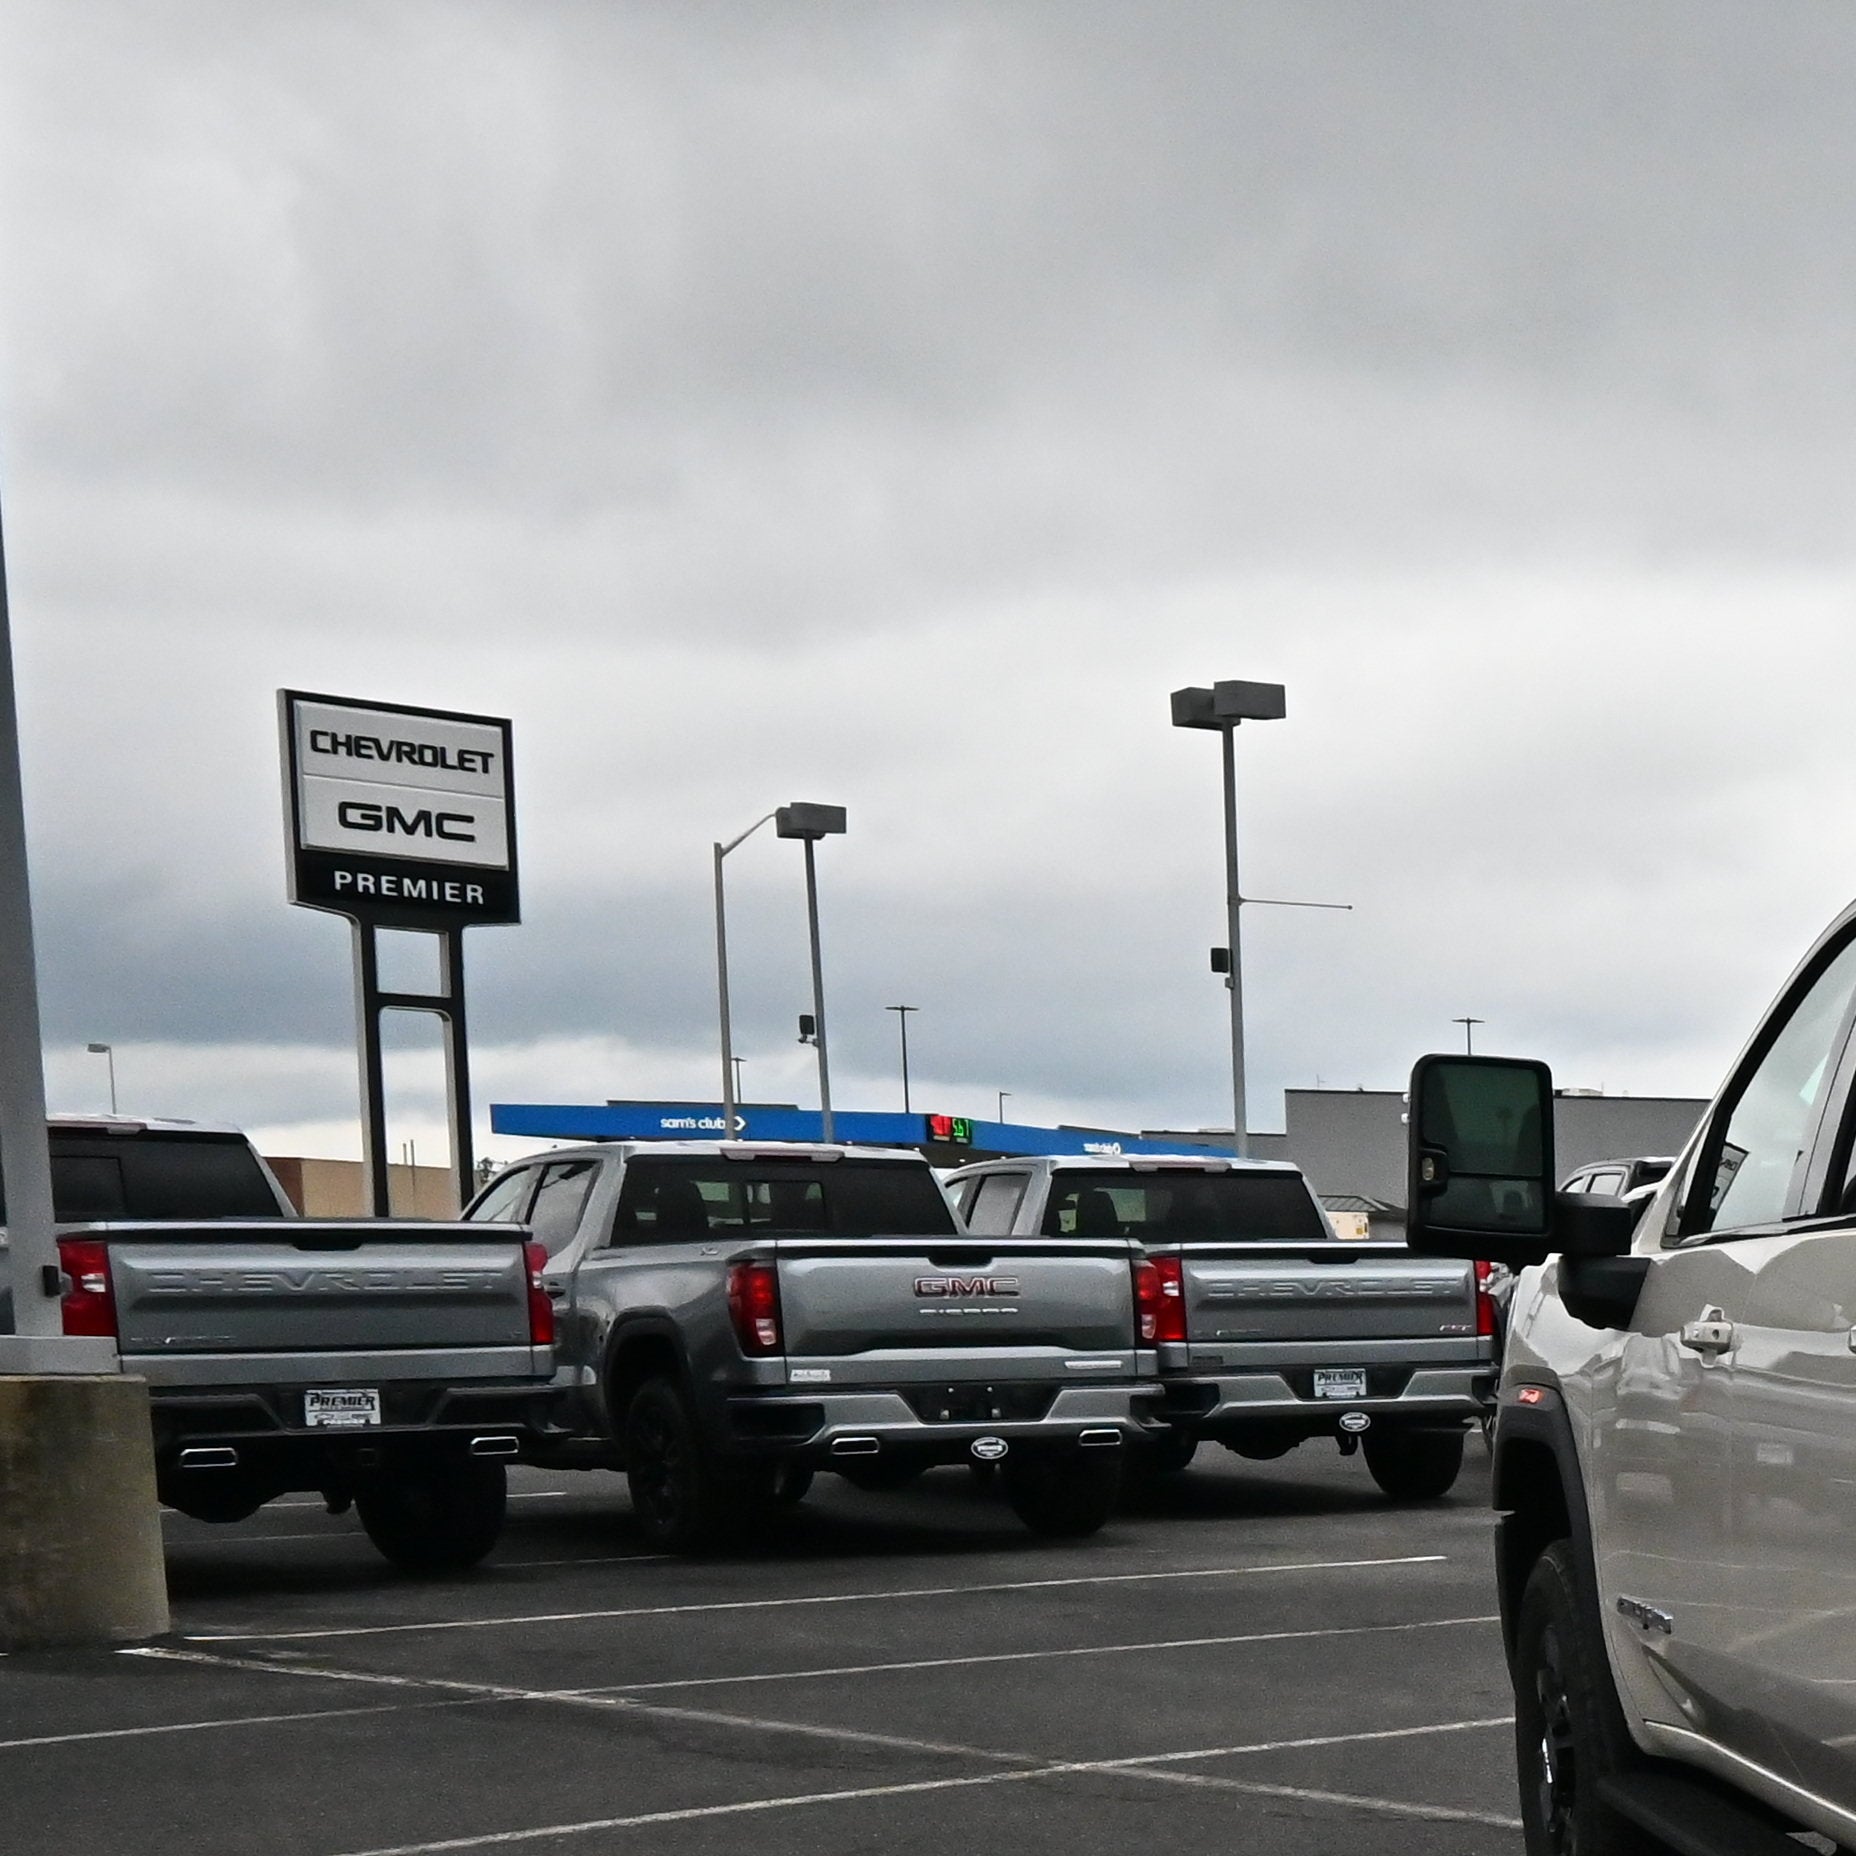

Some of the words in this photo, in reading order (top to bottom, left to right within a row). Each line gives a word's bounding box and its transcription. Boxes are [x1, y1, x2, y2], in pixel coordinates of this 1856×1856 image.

[309, 729, 495, 775] CHEVROLET
[337, 801, 476, 843] GMC
[333, 870, 485, 905] PREMIER
[660, 1117, 697, 1129] sam's
[698, 1117, 726, 1130] club
[147, 1269, 503, 1294] CHEVROLET
[914, 1276, 1020, 1299] GMC
[1206, 1279, 1460, 1297] CHEVROLET
